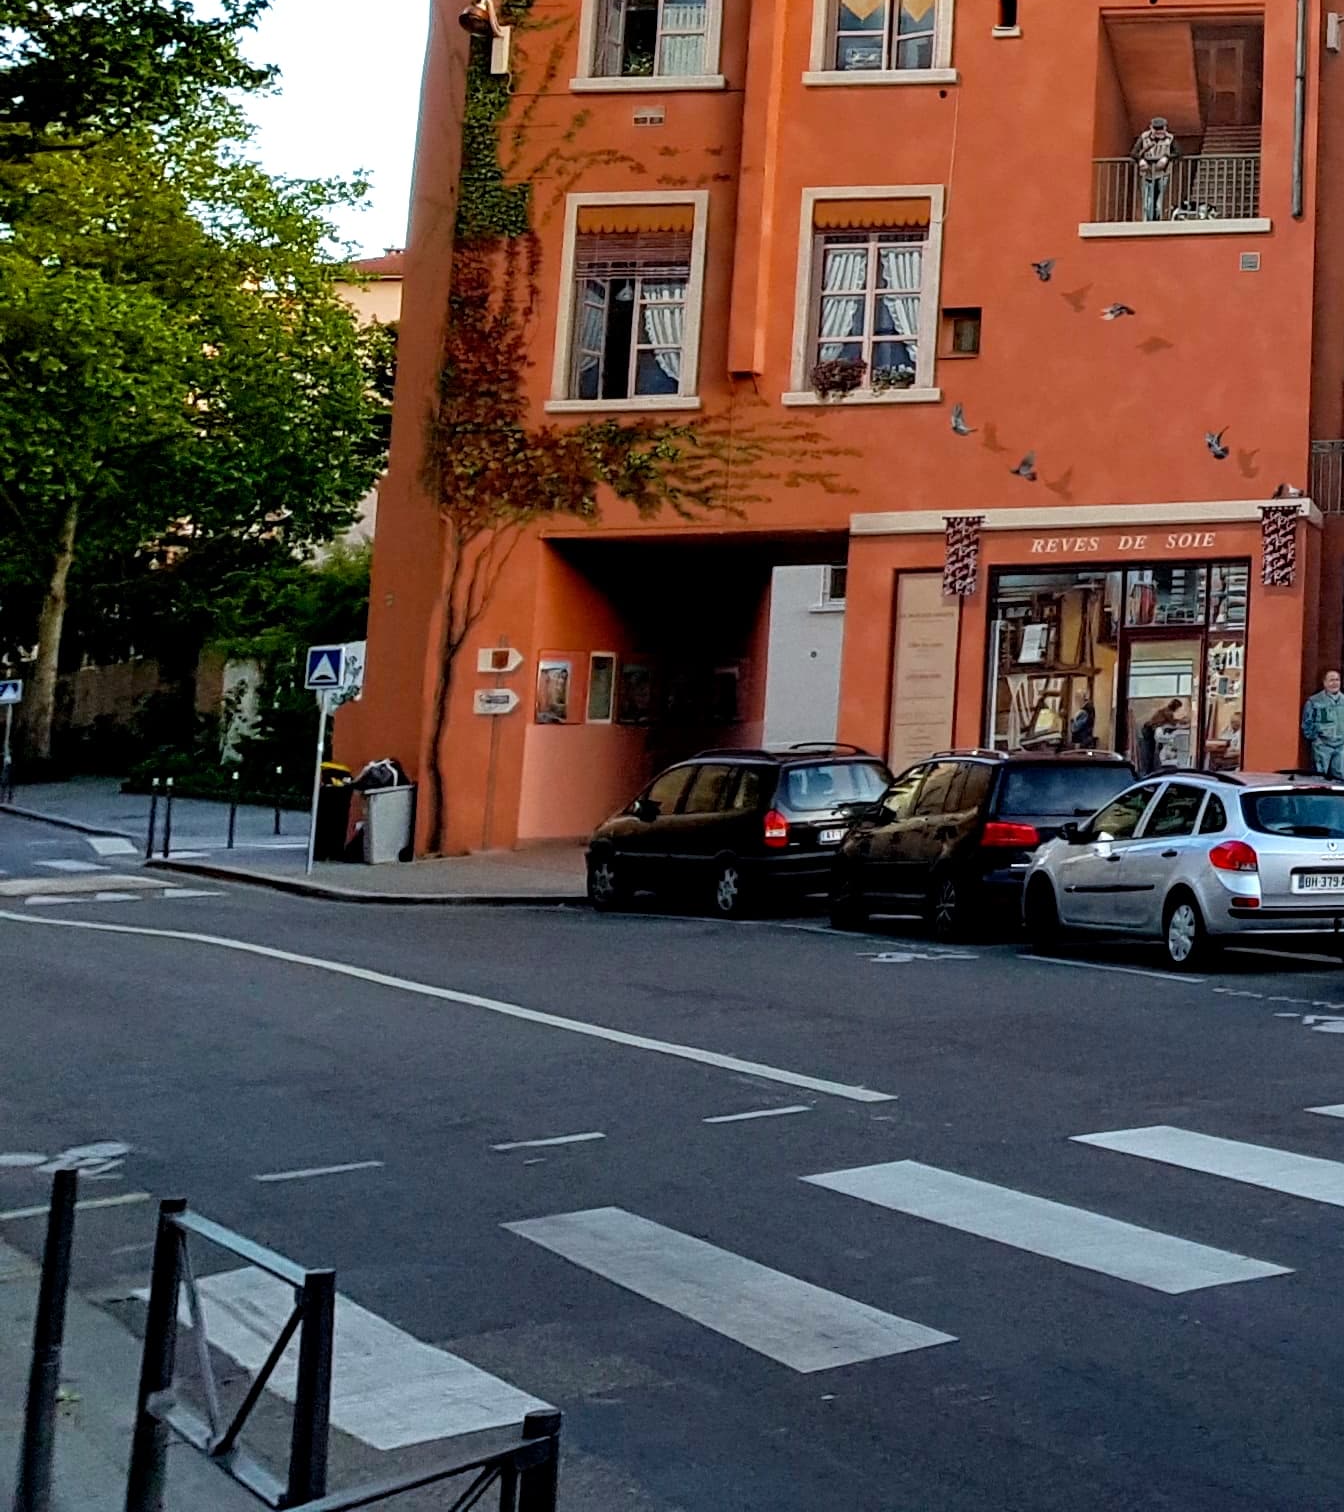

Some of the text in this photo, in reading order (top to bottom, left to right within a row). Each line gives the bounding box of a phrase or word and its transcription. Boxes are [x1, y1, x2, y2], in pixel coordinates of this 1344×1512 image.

[1031, 532, 1216, 553] REVES DE SOIE
